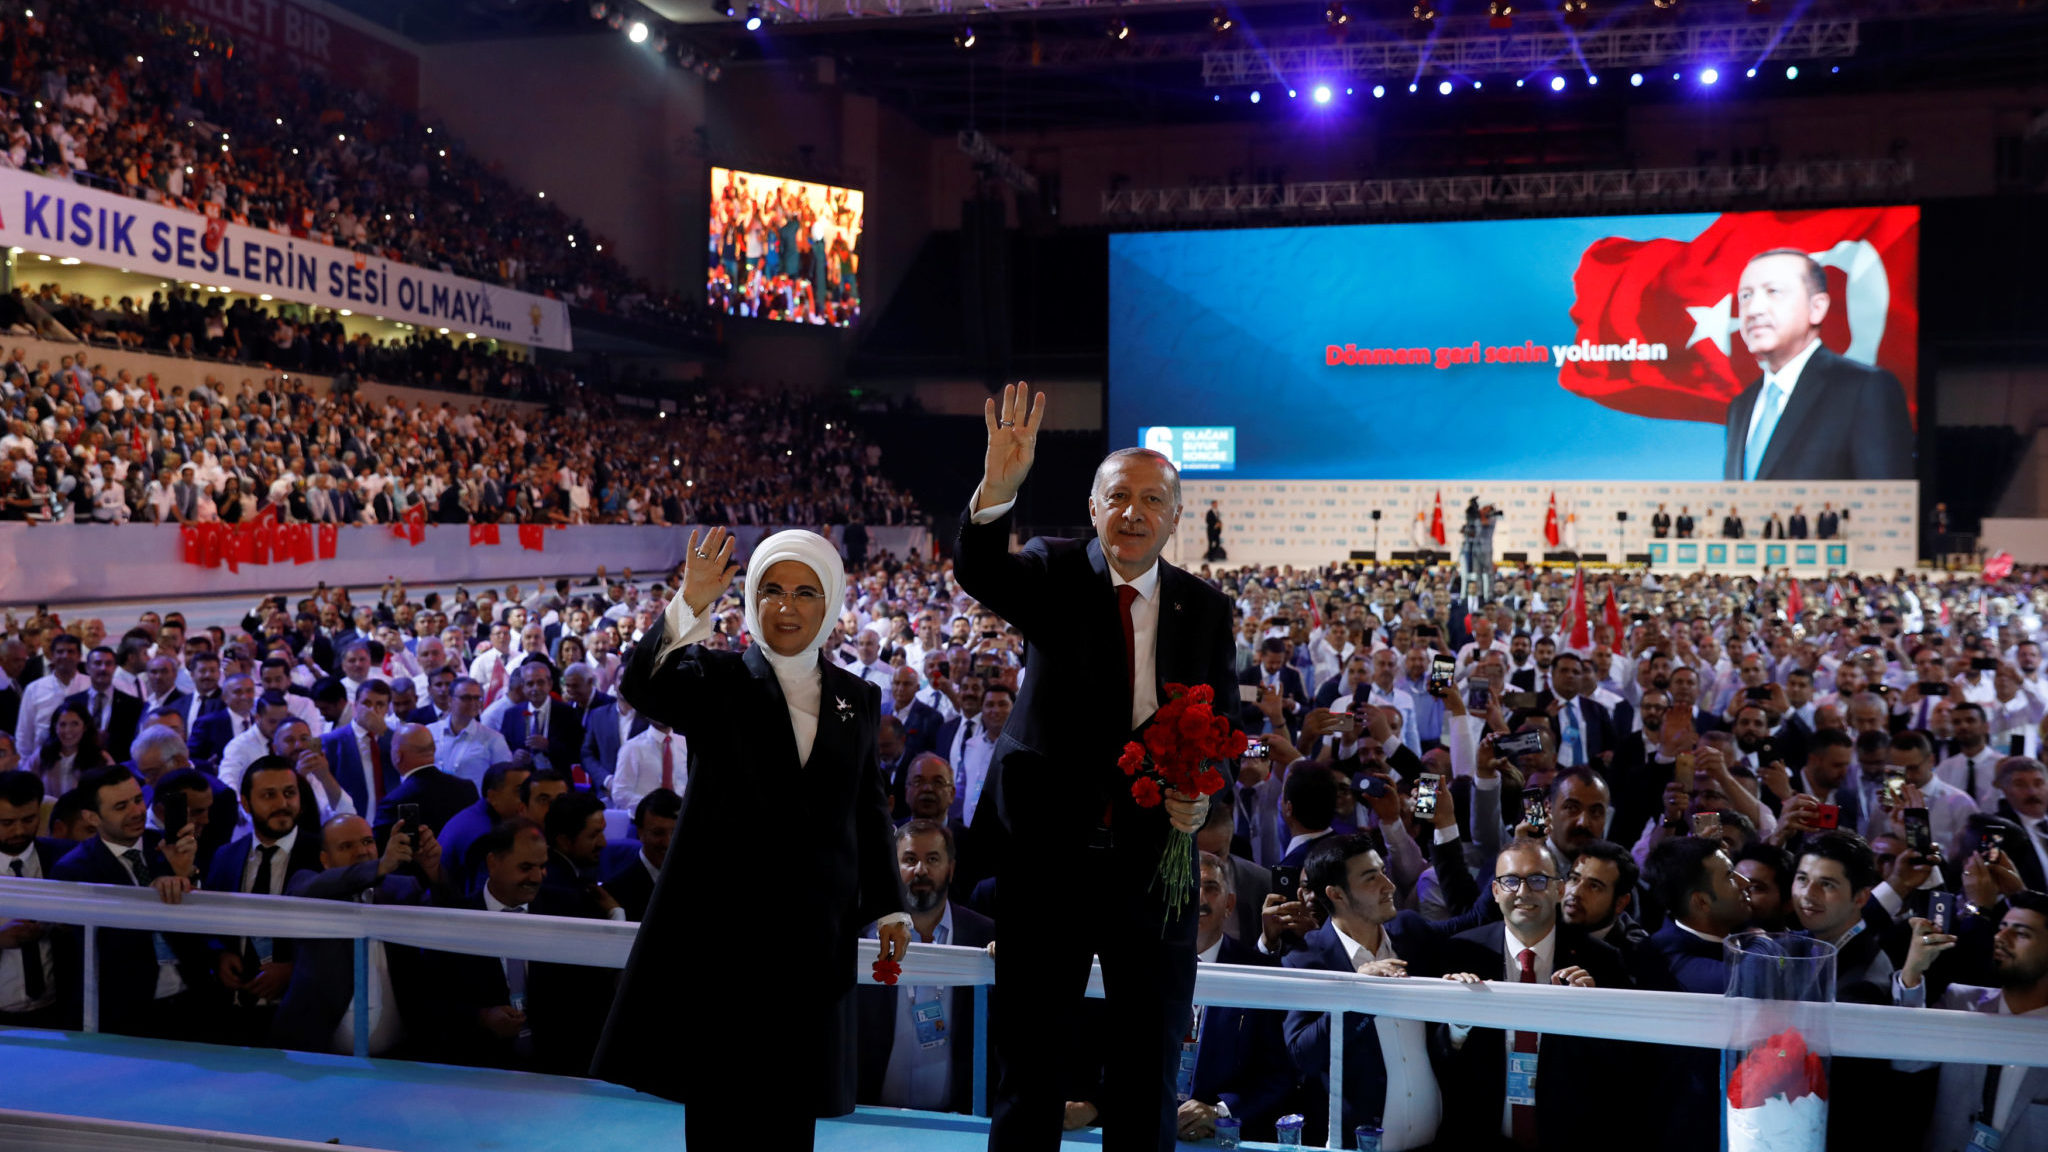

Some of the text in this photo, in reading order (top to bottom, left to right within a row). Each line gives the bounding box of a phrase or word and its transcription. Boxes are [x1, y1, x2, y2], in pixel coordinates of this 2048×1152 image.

[285, 6, 332, 61] BİR
[24, 190, 137, 257] KISIK
[152, 221, 317, 292] SESLERİN
[328, 261, 387, 306] SESİ
[1325, 338, 1668, 369] Dönmem geri senin yolundan
